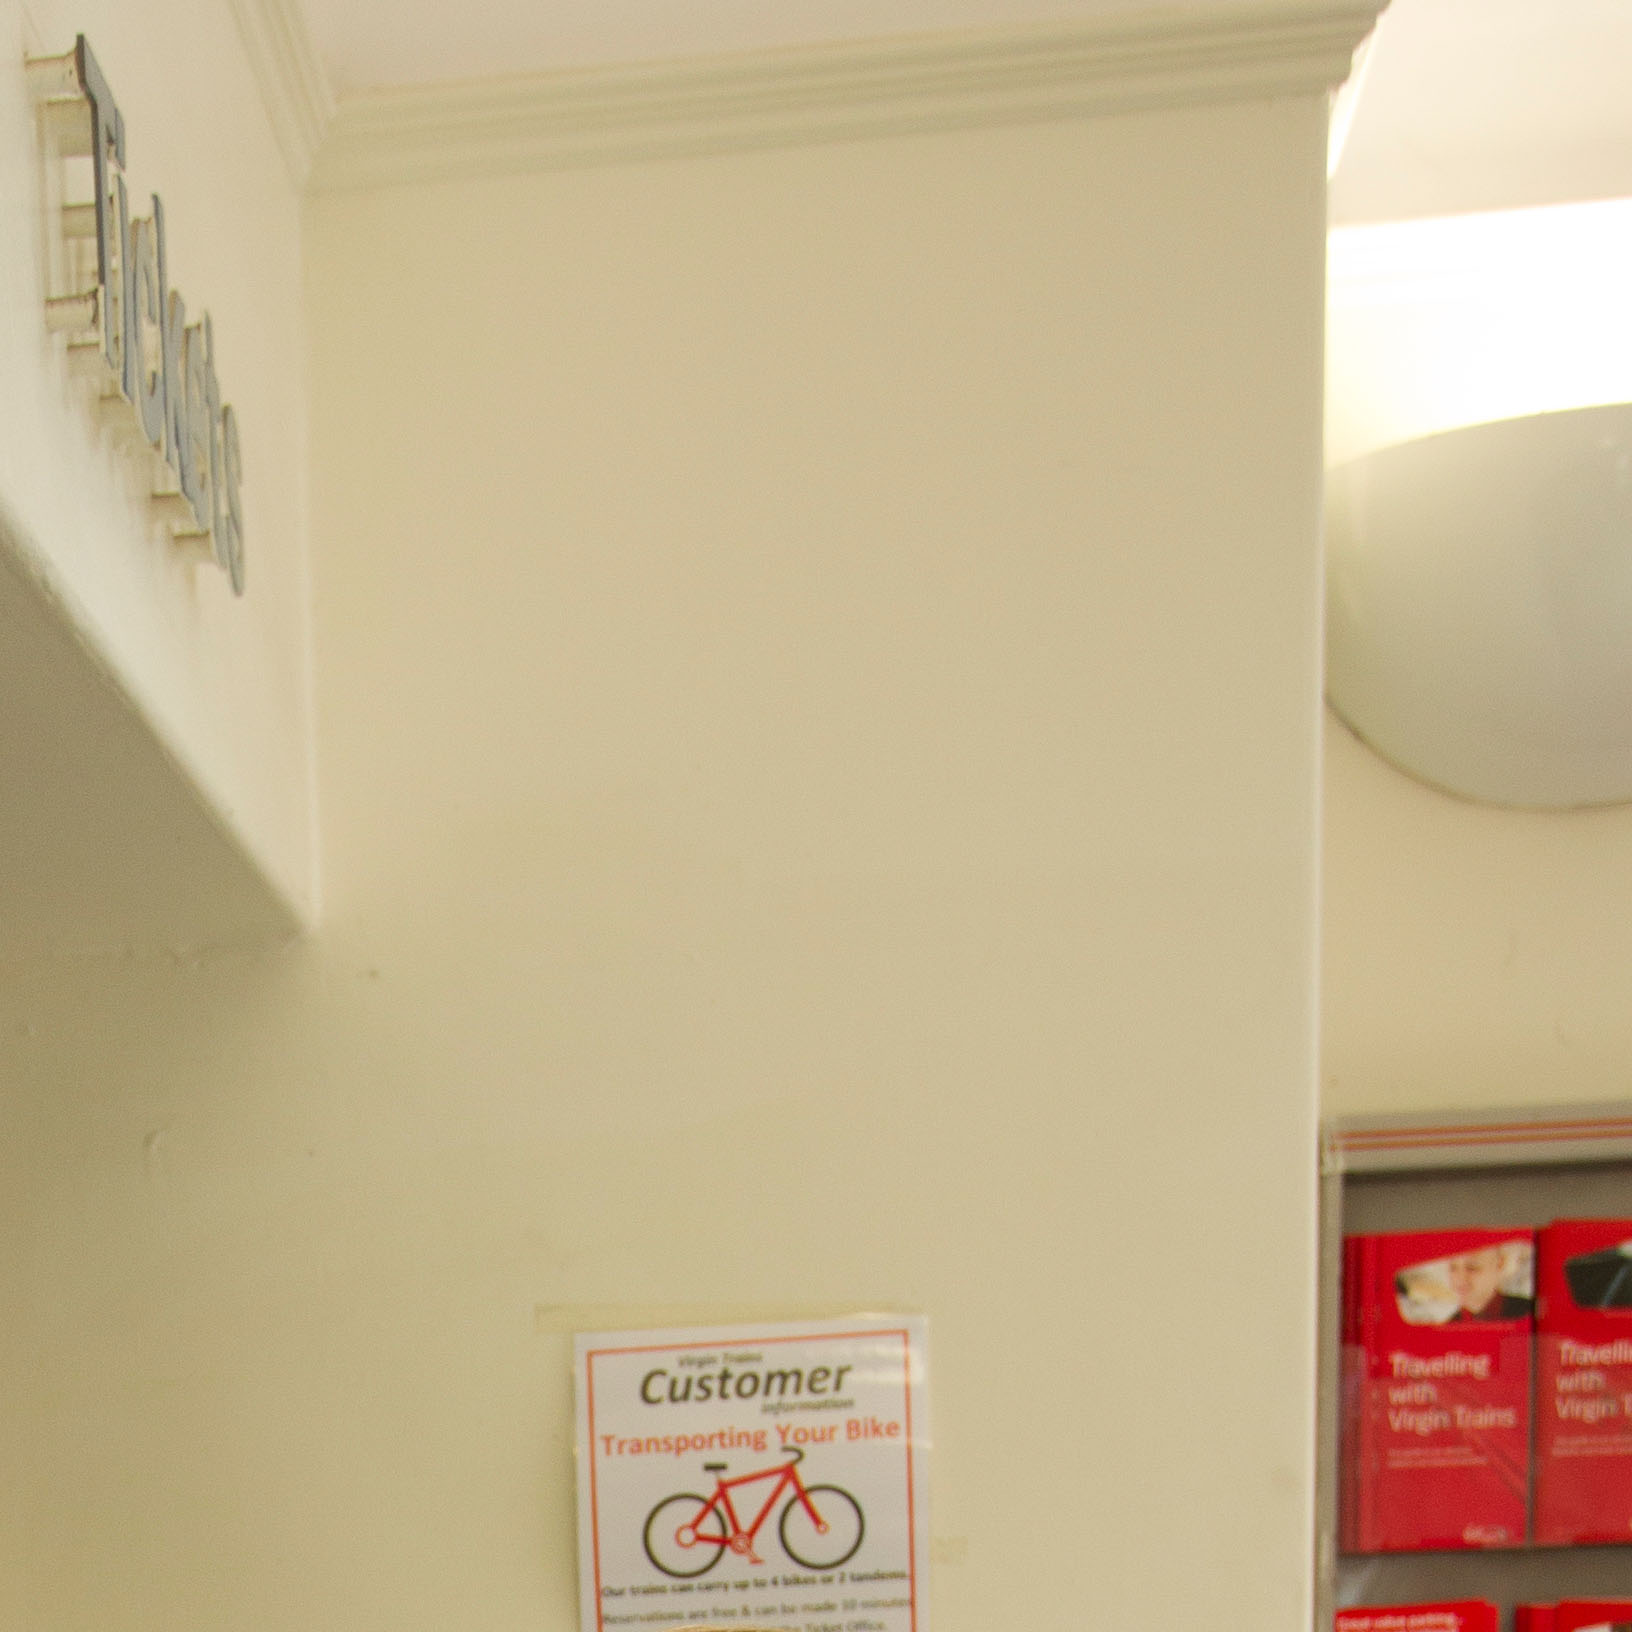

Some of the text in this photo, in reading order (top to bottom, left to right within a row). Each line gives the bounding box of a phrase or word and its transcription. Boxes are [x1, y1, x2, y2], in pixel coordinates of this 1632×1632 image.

[1390, 1350, 1489, 1381] Travelling
[1556, 1369, 1606, 1393] with
[639, 1363, 853, 1405] Customer
[1388, 1381, 1437, 1405] with
[1387, 1405, 1516, 1436] Virgin Trains
[1555, 1396, 1619, 1425] Virgin
[601, 1416, 901, 1457] Transporting Your Bike
